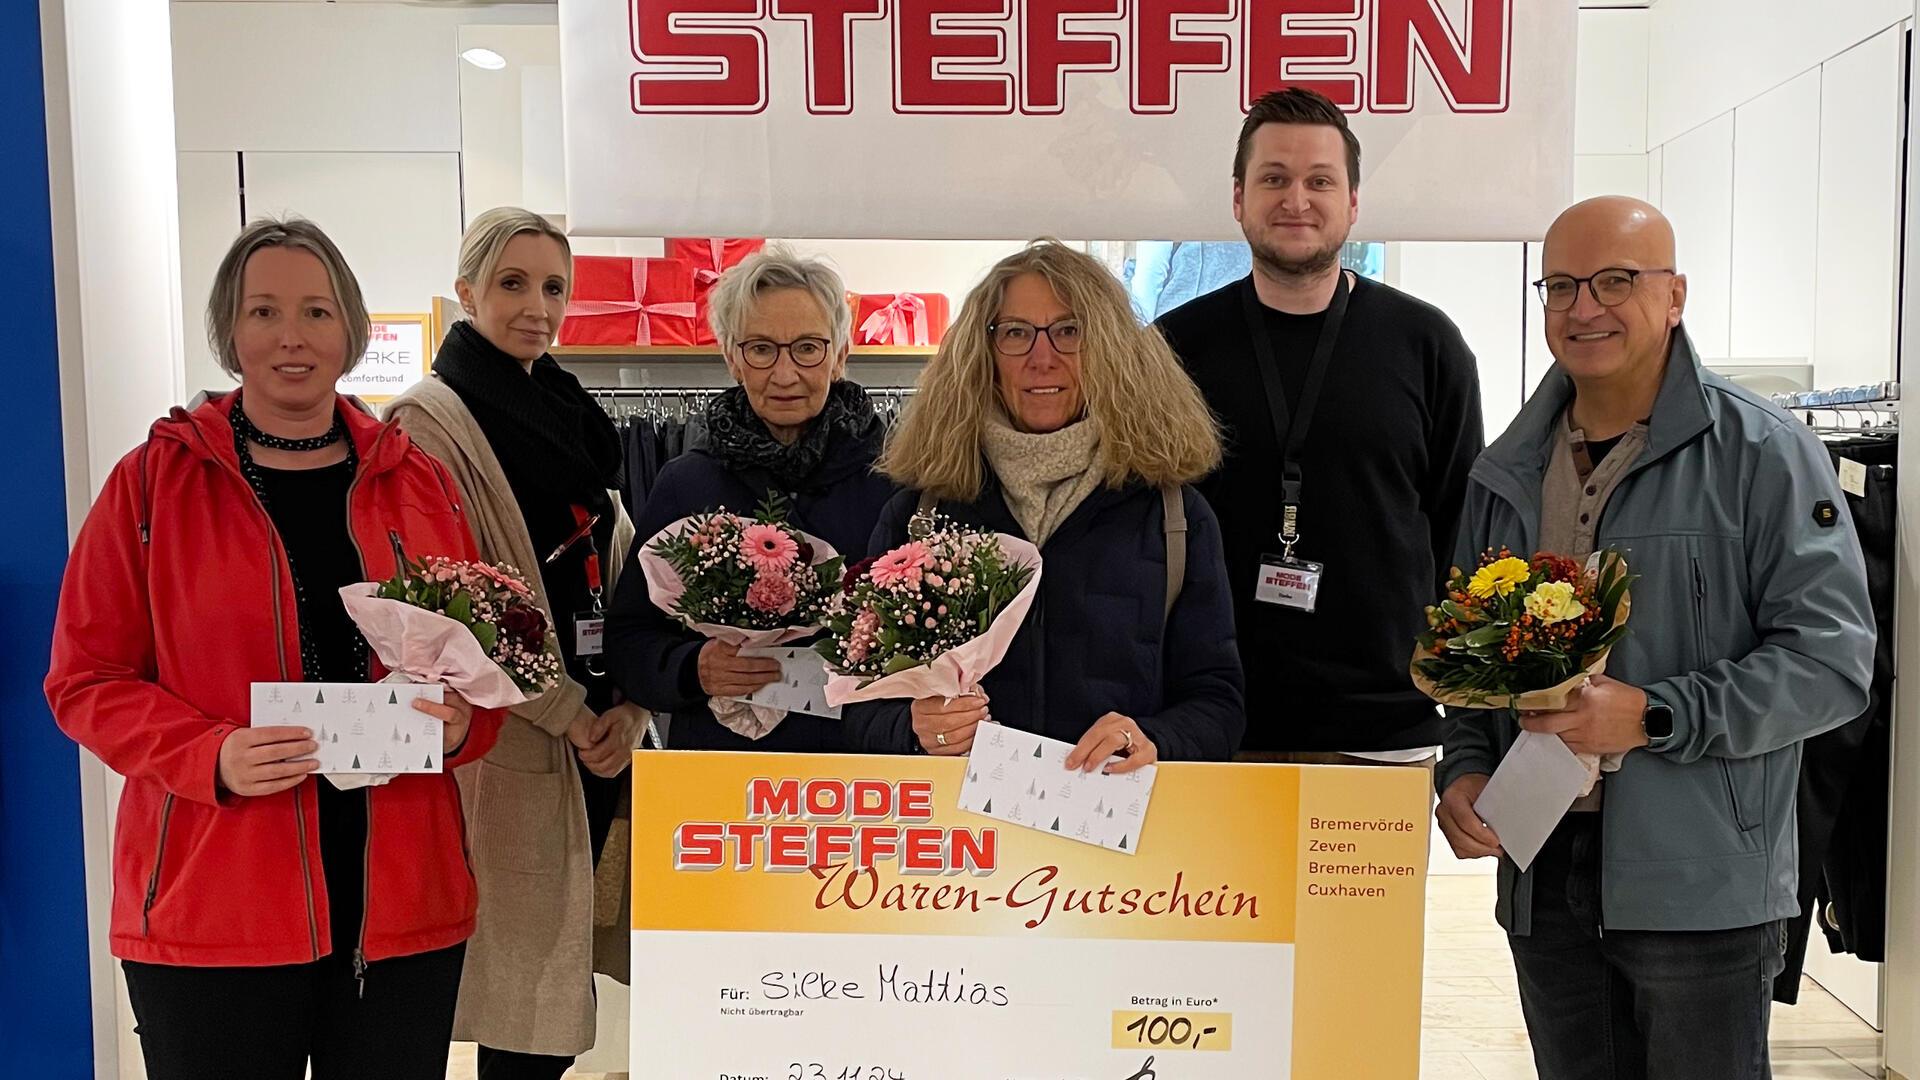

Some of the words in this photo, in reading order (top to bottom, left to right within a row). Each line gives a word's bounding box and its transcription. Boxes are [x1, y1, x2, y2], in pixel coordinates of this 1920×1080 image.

[630, 0, 1511, 116] STEFFEN
[365, 351, 411, 364] RKE
[747, 777, 934, 823] MODE
[1310, 817, 1414, 833] Bremervörde
[674, 822, 998, 876] STEFFEN
[1309, 839, 1356, 853] Zeven
[1308, 861, 1415, 877] Bremerhaven
[808, 862, 1259, 929] Waren-Gutschein
[1307, 883, 1386, 898] Cuxhaven
[761, 971, 865, 1000] Silke
[879, 963, 1009, 1006] Mattias
[720, 987, 750, 1000] Für:
[1131, 995, 1168, 1007] Betrag
[1172, 995, 1182, 1006] in
[720, 1007, 745, 1016] Nicht
[749, 1007, 804, 1018] übertragbar
[1127, 1014, 1217, 1050] 100,-
